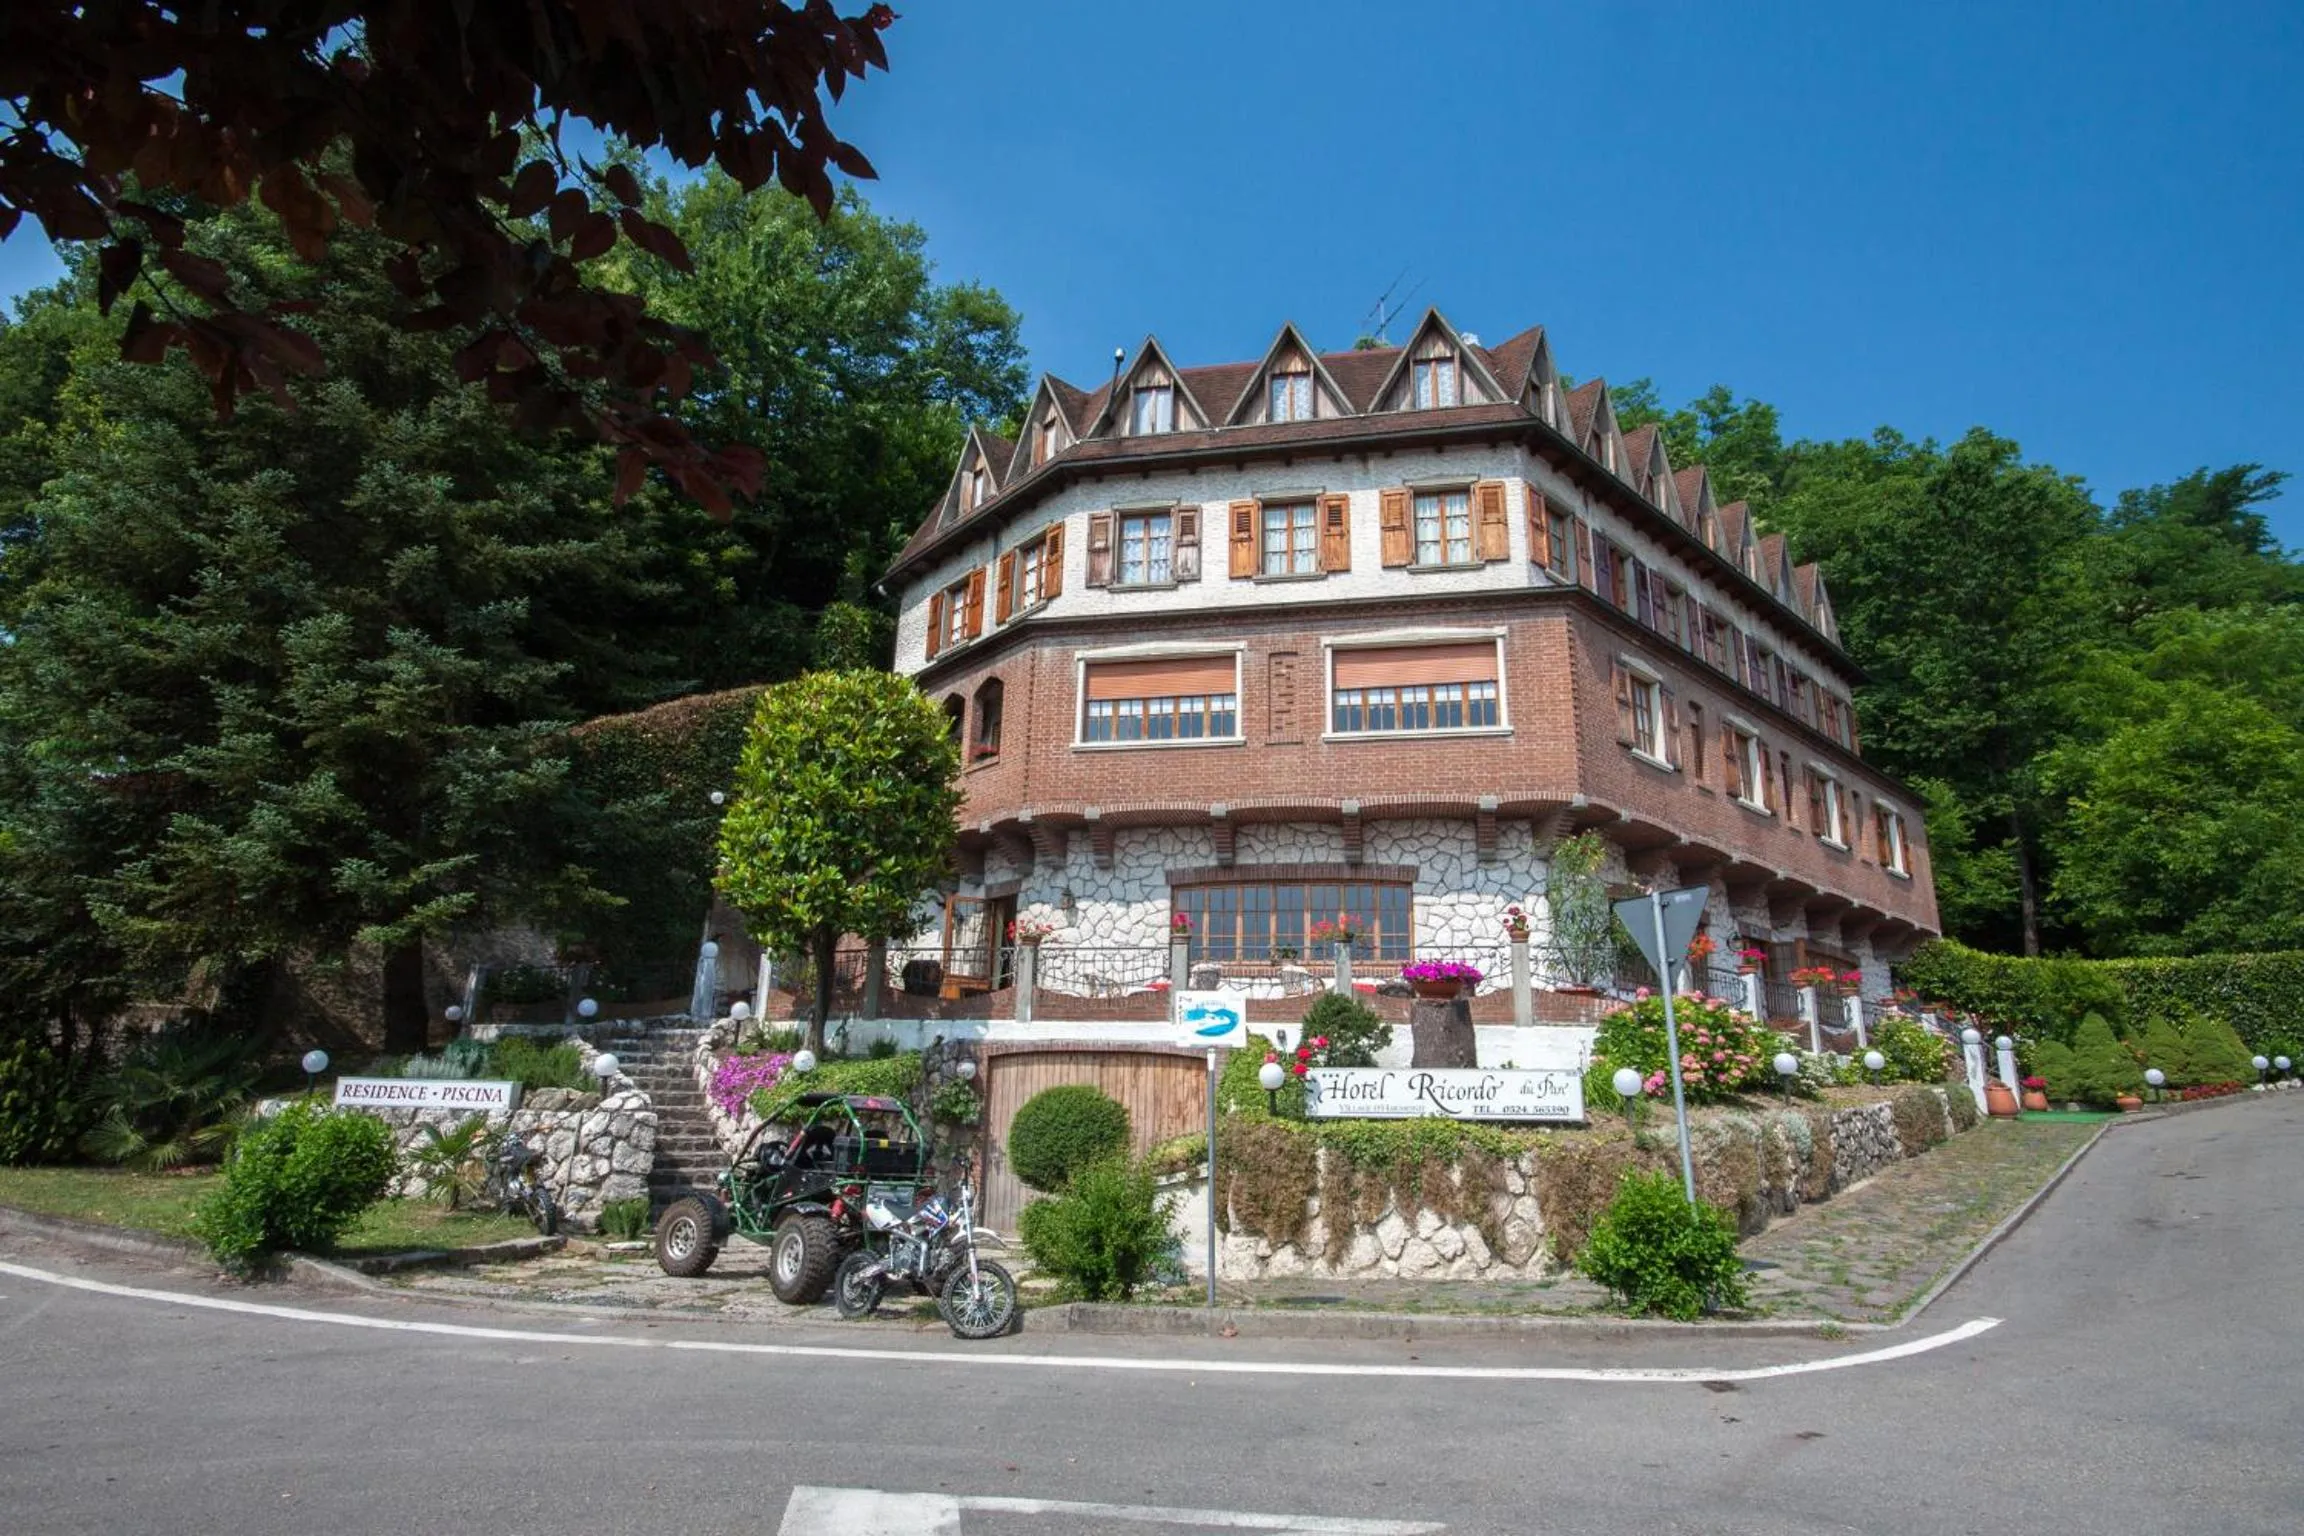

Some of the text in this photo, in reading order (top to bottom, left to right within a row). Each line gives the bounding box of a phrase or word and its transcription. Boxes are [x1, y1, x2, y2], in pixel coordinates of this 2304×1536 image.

[342, 1083, 503, 1102] RESIDENCE PISCINA
[1322, 1072, 1395, 1100] Hotel
[1407, 1073, 1504, 1114] Ricordo
